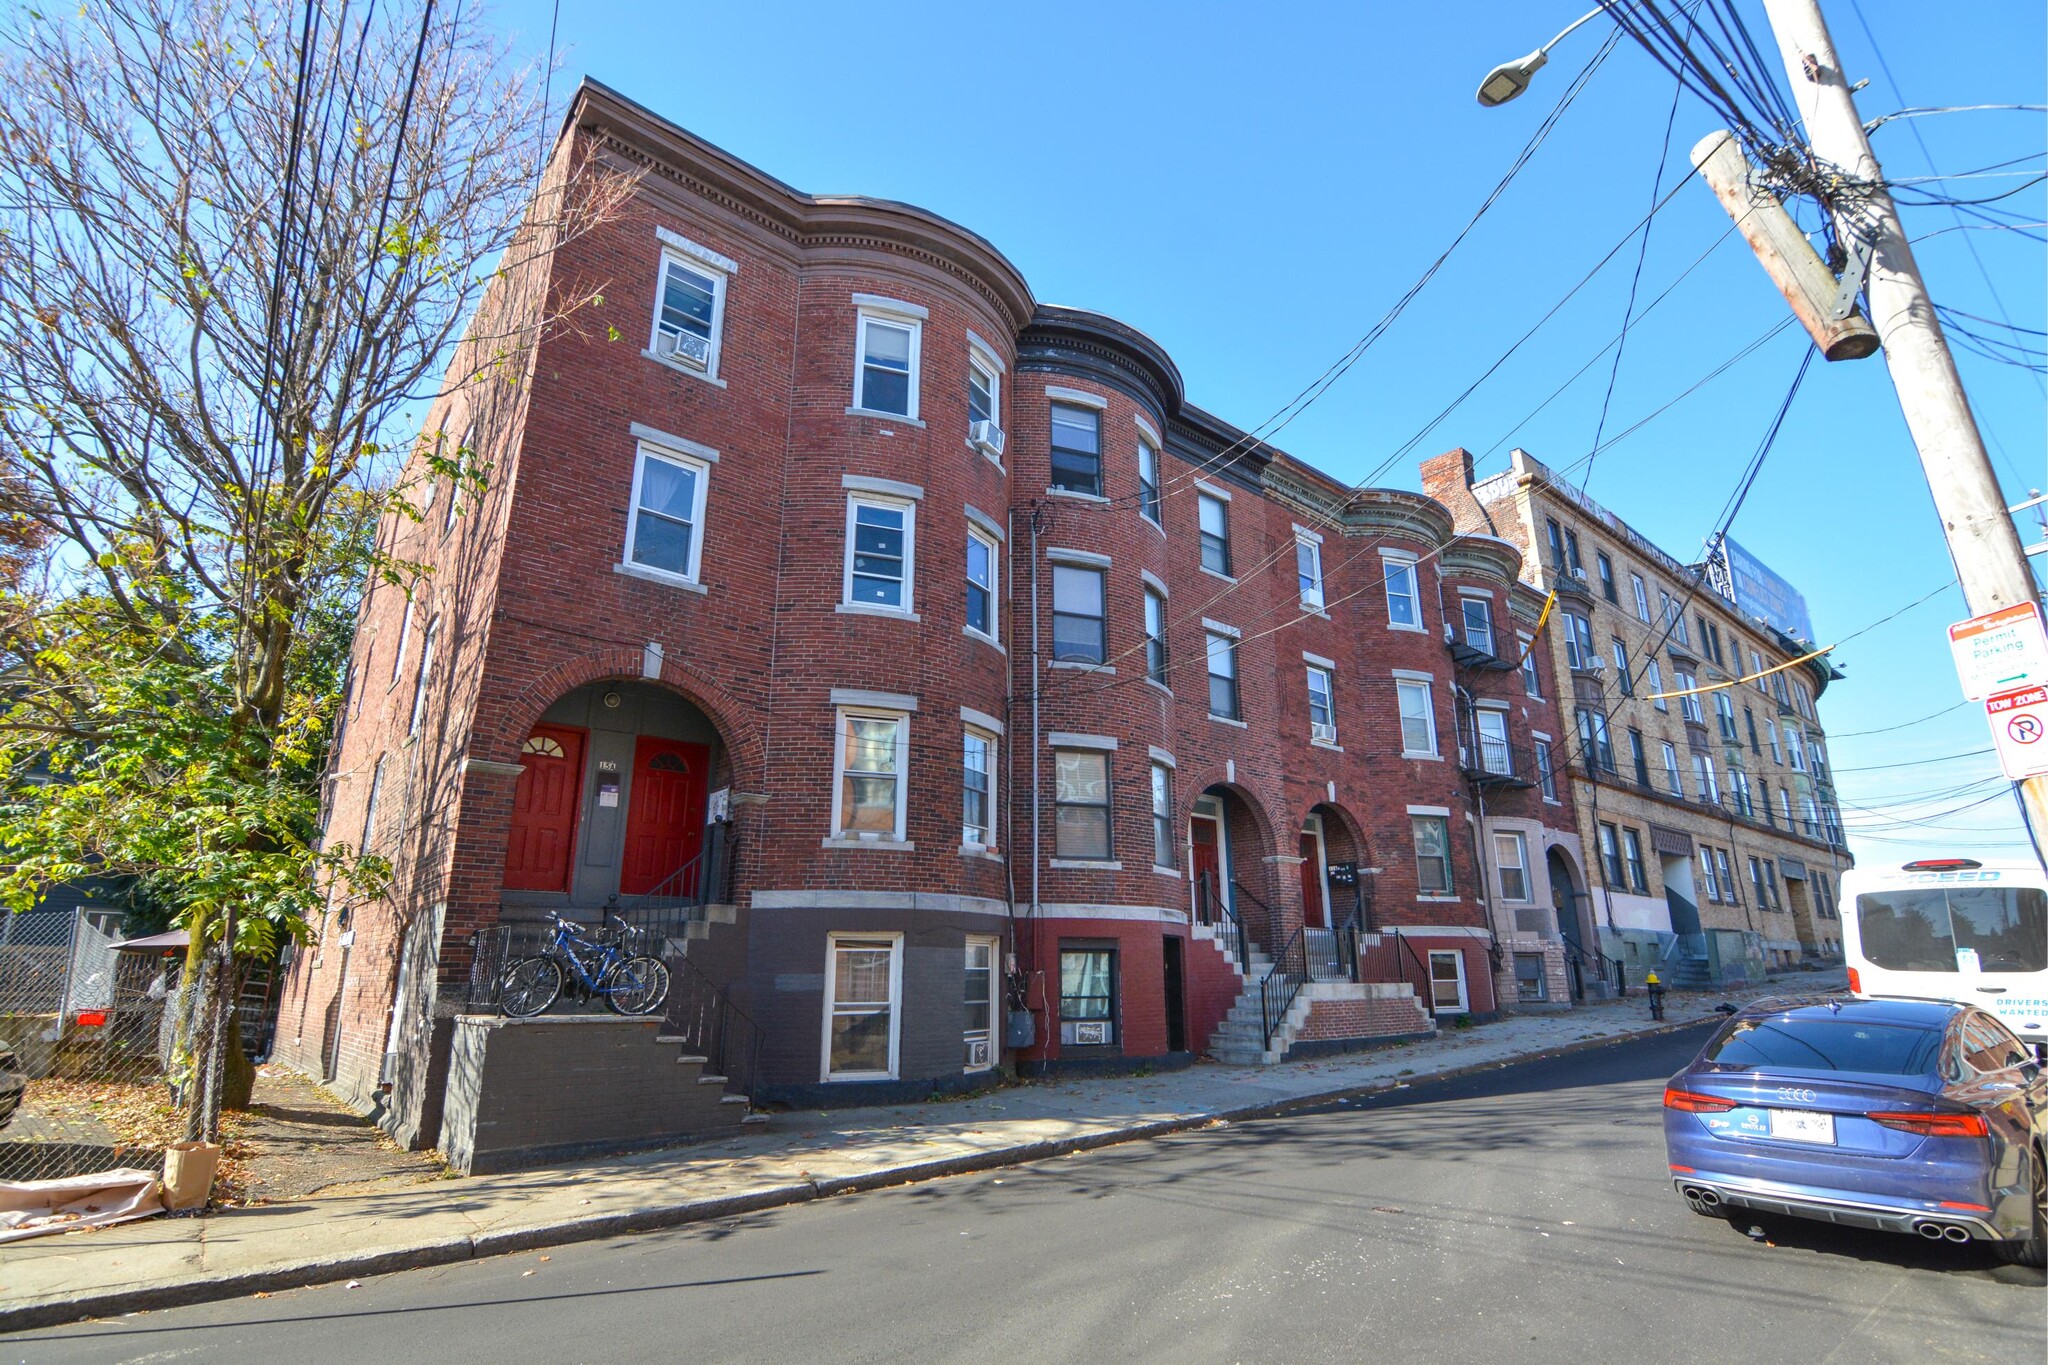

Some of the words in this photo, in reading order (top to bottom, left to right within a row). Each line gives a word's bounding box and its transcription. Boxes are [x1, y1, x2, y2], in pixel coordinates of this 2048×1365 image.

[1973, 630, 2016, 647] Permit
[1973, 641, 2025, 660] Parking
[1987, 698, 2012, 711] TOW
[2013, 692, 2046, 706] ZONE
[1996, 998, 2048, 1007] DRIVERS
[1999, 1009, 2048, 1017] WANTED
